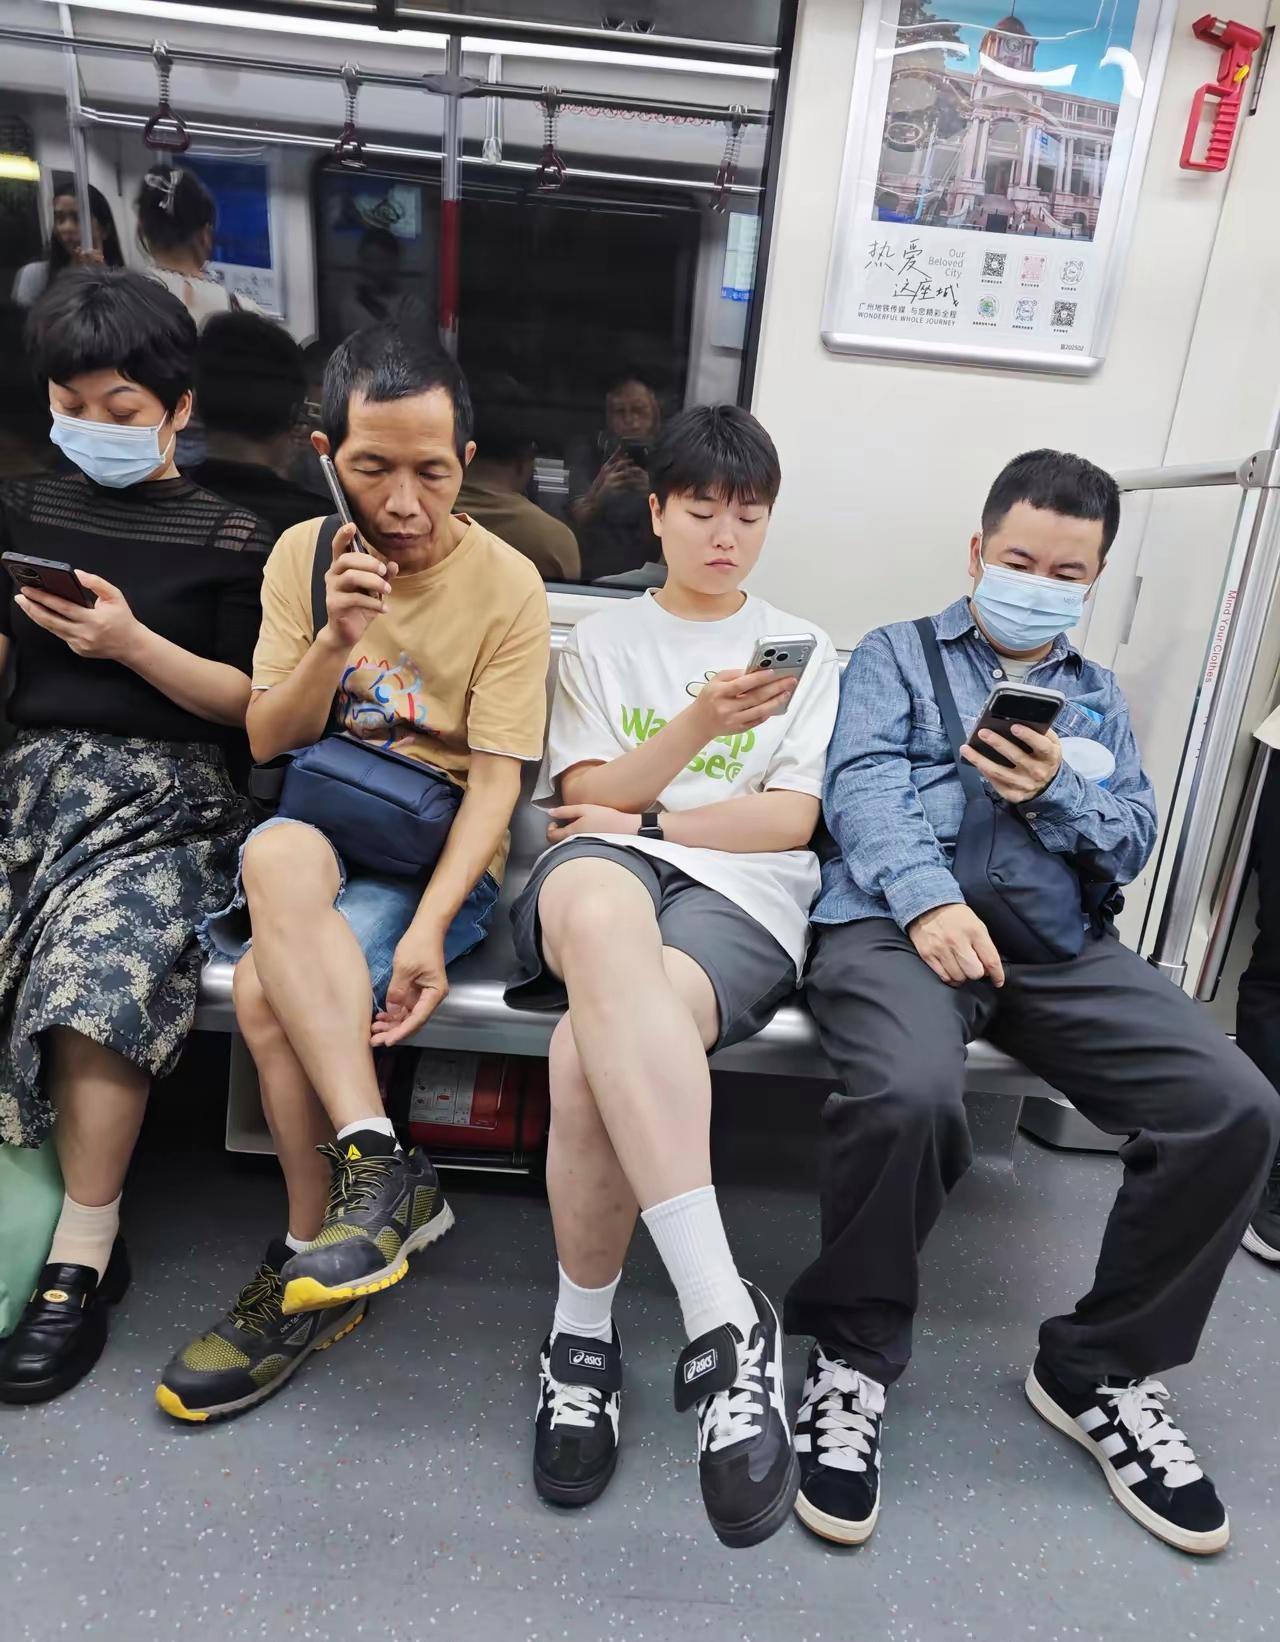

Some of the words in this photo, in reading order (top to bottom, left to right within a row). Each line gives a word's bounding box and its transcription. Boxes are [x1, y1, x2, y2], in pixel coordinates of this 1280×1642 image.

[864, 238, 932, 279] 热爱
[928, 256, 964, 268] Beloved
[948, 248, 966, 258] Our
[944, 267, 962, 279] City
[892, 277, 959, 307] 这座城
[857, 311, 898, 321] WONDERFUL
[900, 315, 924, 324] WHOLE
[925, 317, 956, 327] JOURNEY
[1223, 590, 1239, 615] Mind
[1216, 619, 1228, 641] Your
[1205, 644, 1222, 683] Clothes
